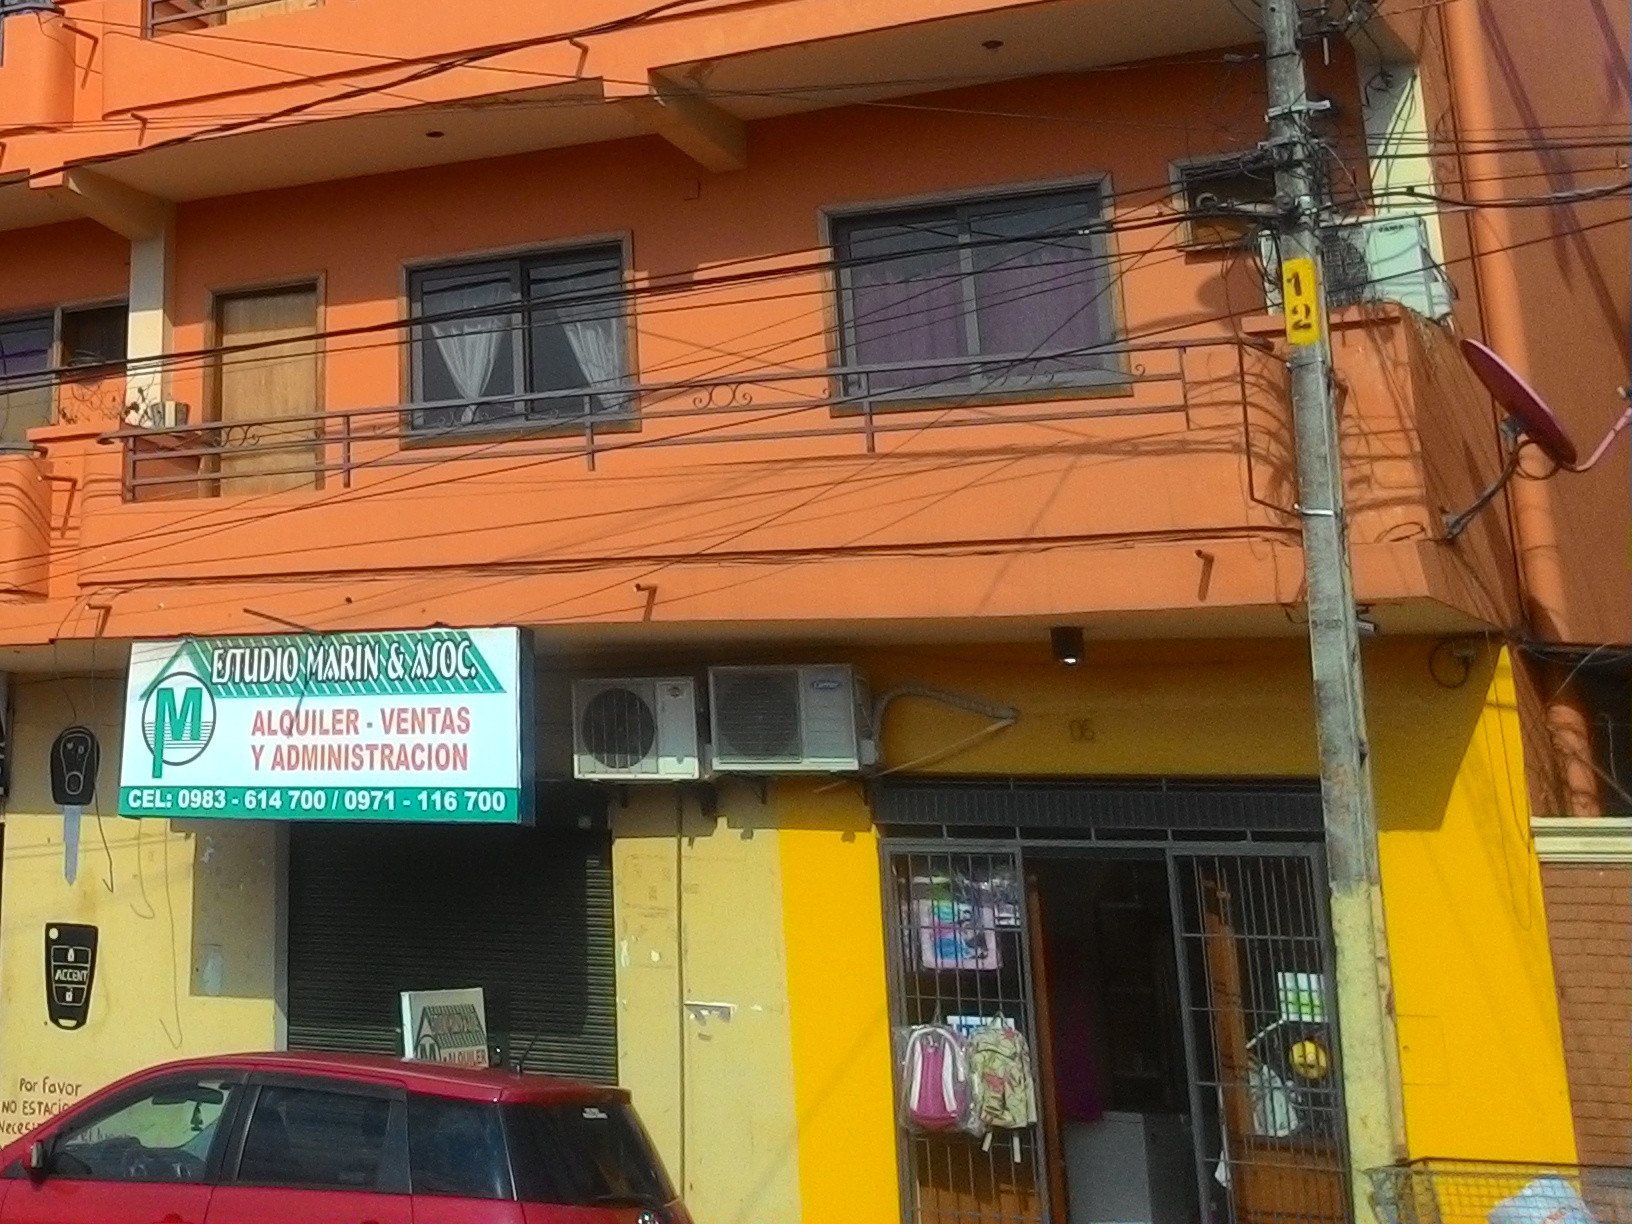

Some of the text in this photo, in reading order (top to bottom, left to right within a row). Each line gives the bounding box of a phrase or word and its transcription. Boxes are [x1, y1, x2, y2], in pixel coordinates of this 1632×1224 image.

[212, 641, 477, 685] ESTUDIO MARIN & ASOC.
[251, 708, 359, 738] ALQUILER
[380, 707, 470, 735] VENTAS
[251, 743, 468, 771] Y ADMINISTRACION
[128, 789, 171, 809] CEL:
[178, 789, 226, 809] 0983
[244, 790, 282, 810] 614
[289, 790, 326, 810] 700
[331, 790, 339, 811] /
[344, 790, 396, 811] 0971
[418, 790, 457, 811] 116
[464, 791, 506, 812] 700
[55, 969, 89, 981] ACCENT
[20, 1078, 38, 1093] Por
[2, 1101, 17, 1114] NO
